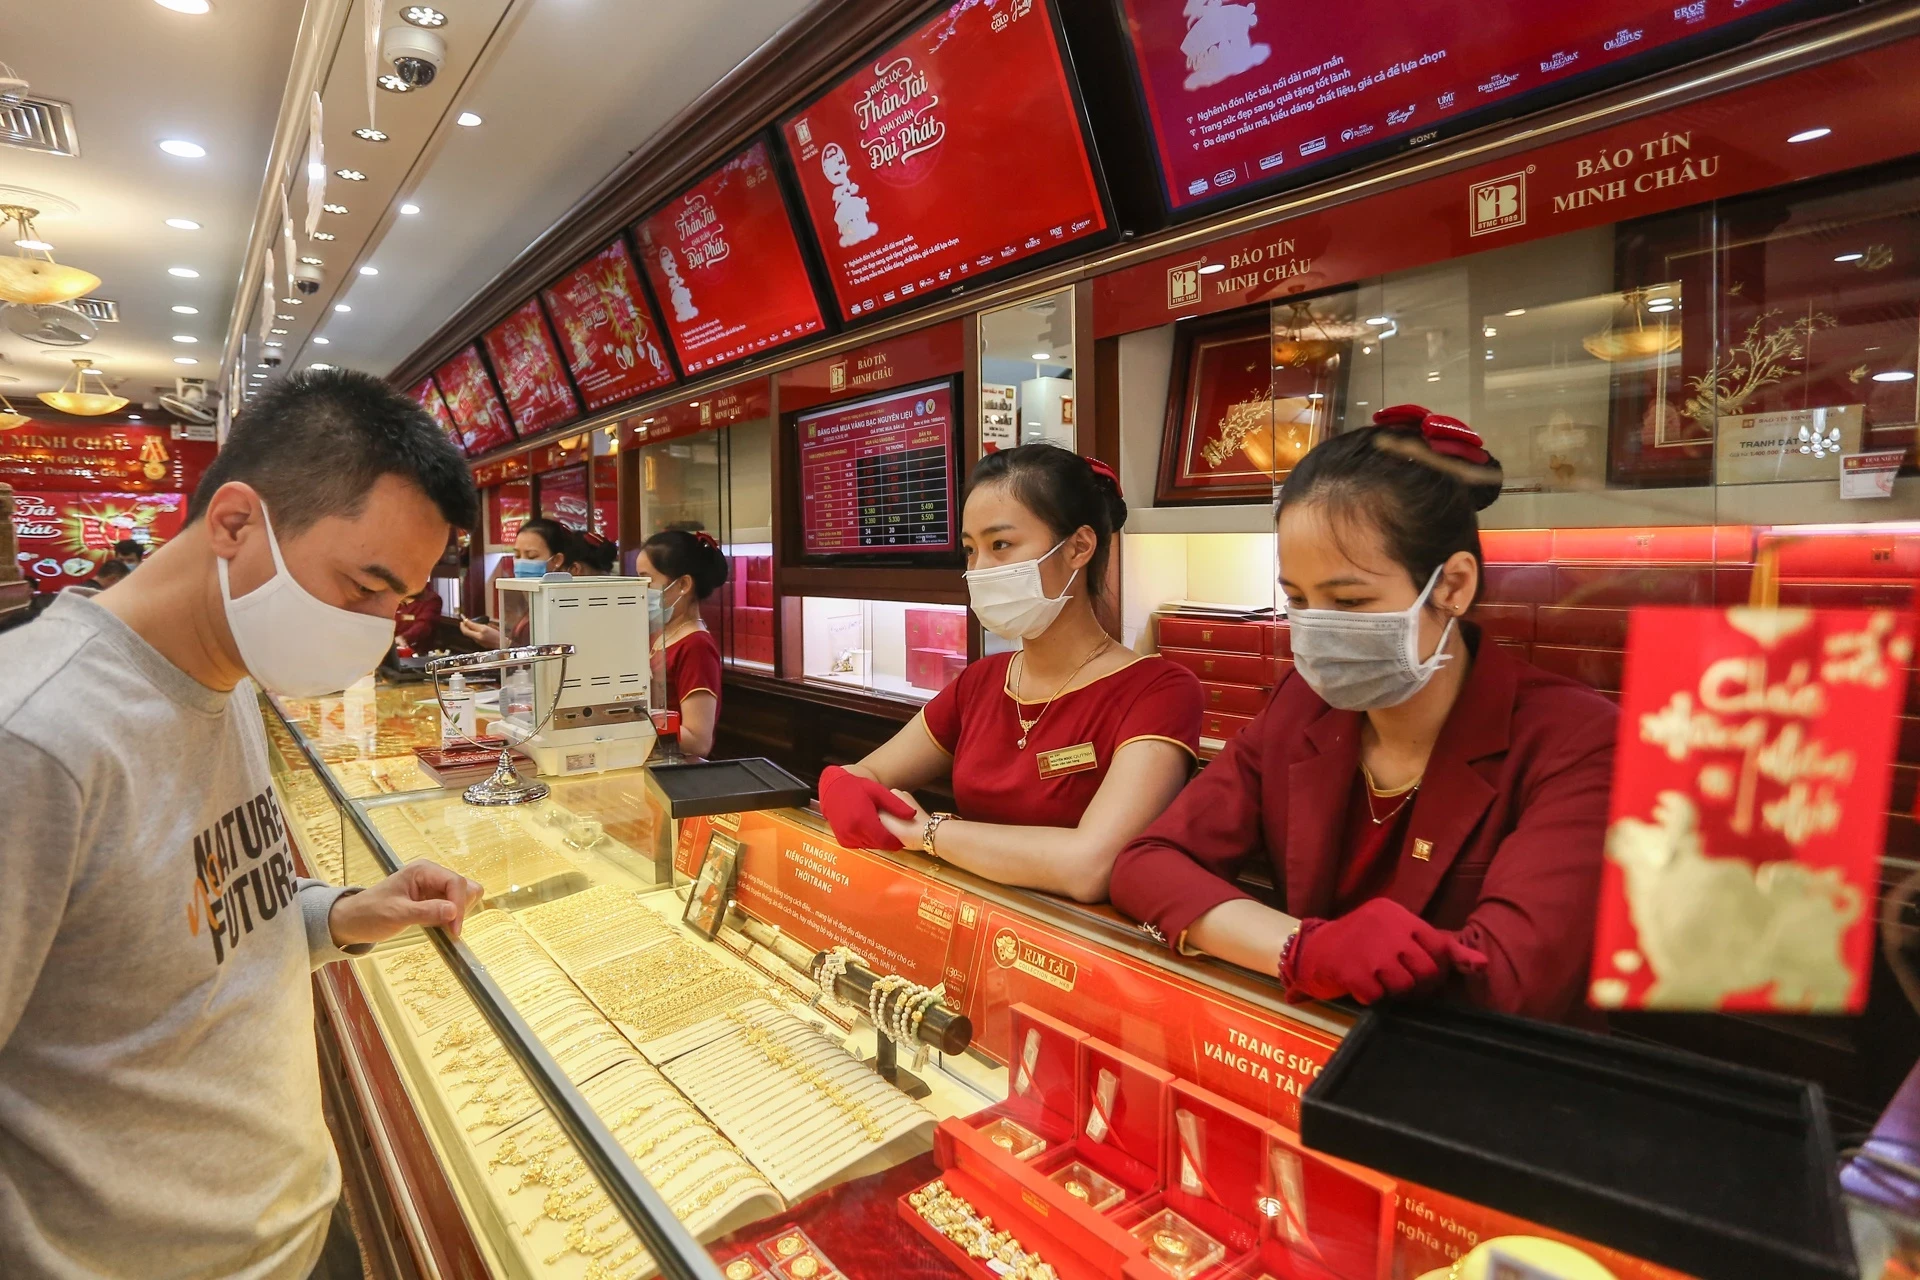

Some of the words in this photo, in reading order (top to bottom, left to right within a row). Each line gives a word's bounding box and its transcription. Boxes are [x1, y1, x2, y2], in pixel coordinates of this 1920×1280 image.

[990, 14, 1009, 30] GOLD
[890, 67, 903, 84] LỘC
[1197, 103, 1228, 122] Nghênh
[1228, 97, 1244, 109] đón
[1245, 92, 1258, 103] lộc
[1258, 84, 1272, 96] tài,
[1272, 77, 1287, 91] nối
[1288, 71, 1302, 84] dài
[1302, 65, 1321, 79] may
[1323, 55, 1344, 70] mắn
[854, 91, 902, 131] Thần
[899, 70, 928, 105] Tài
[1200, 120, 1222, 134] Trang
[1222, 114, 1236, 126] sức
[1237, 108, 1252, 120] đẹp
[1254, 100, 1276, 114] sang,
[1276, 92, 1293, 106] quà
[1294, 84, 1314, 98] tặng
[1315, 76, 1330, 89] tốt
[1330, 68, 1351, 84] lành
[1203, 138, 1214, 148] Đa
[1215, 130, 1236, 143] dạng
[1290, 100, 1315, 115] dáng,
[1316, 90, 1336, 105] chất
[1358, 76, 1372, 91] giá
[1374, 70, 1386, 83] cả
[1401, 61, 1418, 73] lựa
[1418, 49, 1446, 66] chọn
[878, 118, 895, 136] KHAI
[895, 108, 914, 128] XUÂN
[865, 138, 900, 170] Đại
[898, 115, 942, 154] Phát
[1410, 131, 1438, 145] SONY
[1576, 149, 1633, 180] BẢO
[1640, 131, 1692, 162] TÍN
[1553, 179, 1627, 214] MINH
[1634, 155, 1721, 194] CHÂU
[1478, 218, 1498, 230] BTMC
[1500, 214, 1518, 224] 1989
[1230, 248, 1263, 270] BẢO
[1266, 238, 1296, 260] TÍN
[1216, 272, 1260, 294] MINH
[1263, 258, 1312, 283] CHÂU
[852, 372, 872, 386] MINH
[872, 366, 894, 382] CHÂU
[858, 356, 873, 370] BẢO
[874, 352, 886, 366] TÍN
[817, 428, 831, 437] BẢNG
[830, 424, 840, 434] GIÁ
[840, 423, 852, 432] MUA
[852, 420, 866, 430] VÀNG
[866, 418, 877, 428] BẠC
[877, 413, 900, 426] NGUYÊN
[900, 410, 913, 421] LIỆU
[10, 434, 67, 449] MINH
[1740, 439, 1775, 448] TRANH
[100, 468, 128, 478] GOLD
[921, 502, 934, 510] 5.490
[194, 785, 284, 894] NATURE
[802, 842, 824, 860] TRANG
[823, 850, 838, 866] SỨC
[794, 867, 810, 882] THỜI
[809, 875, 832, 894] TRANG
[804, 858, 822, 873] VÒNG
[822, 866, 841, 882] VÀNG
[840, 875, 850, 887] TA
[209, 842, 298, 966] FUTURE
[866, 938, 875, 947] mà
[875, 942, 887, 955] sang
[886, 948, 898, 960] quý
[896, 954, 906, 964] cho
[906, 959, 916, 970] các
[1024, 948, 1046, 968] KIM
[1048, 958, 1069, 978] TÀI
[1018, 962, 1048, 980] COLLECTION
[1060, 981, 1070, 989] HKB
[1203, 1038, 1250, 1073] VÀNG
[1248, 1063, 1269, 1084] TA
[1228, 1027, 1284, 1065] TRANG
[1288, 1053, 1325, 1079] SỨC
[1397, 1220, 1439, 1250] nghĩa
[1405, 1197, 1434, 1222] tiền
[1440, 1216, 1478, 1246] vàng
